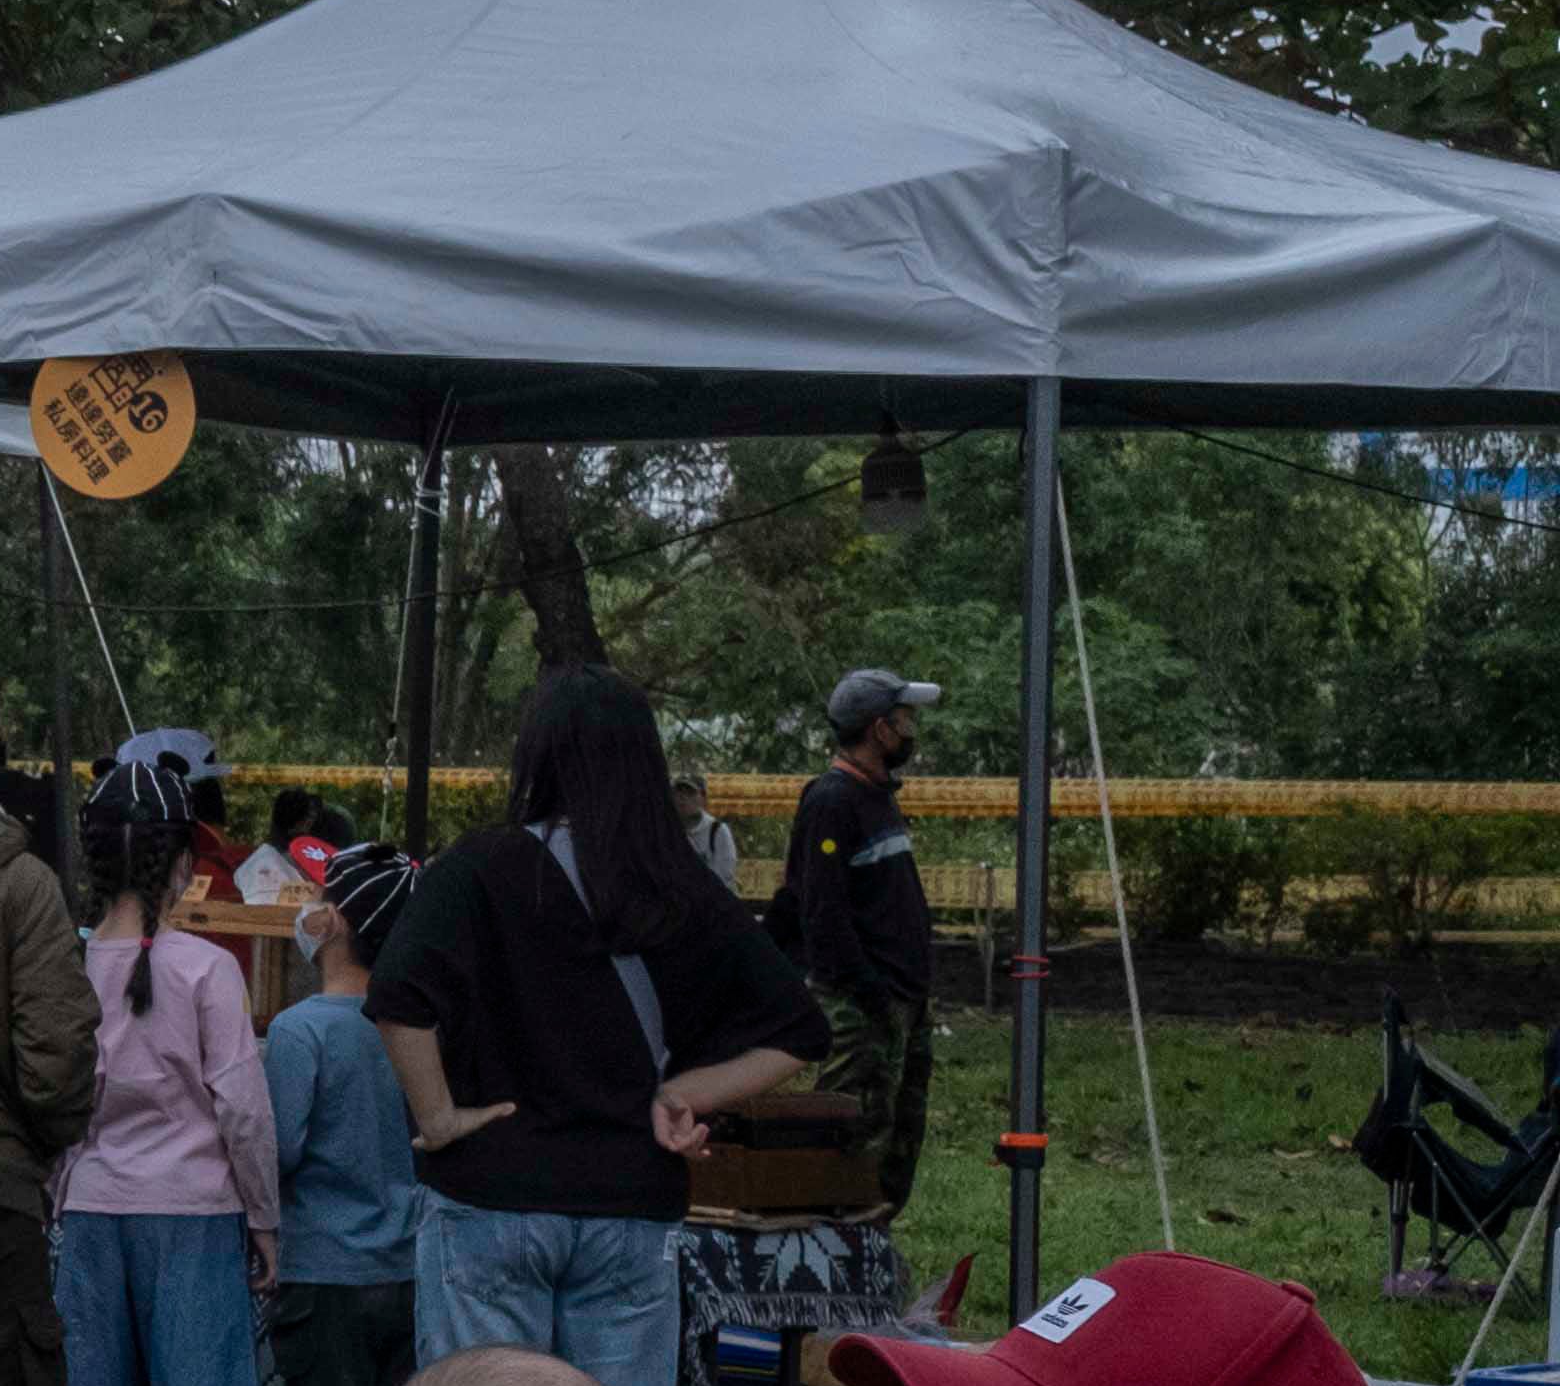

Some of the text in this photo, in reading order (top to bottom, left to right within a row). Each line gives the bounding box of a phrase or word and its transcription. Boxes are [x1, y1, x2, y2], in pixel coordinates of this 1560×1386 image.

[44, 397, 110, 486] 私房料理
[128, 394, 167, 432] 16
